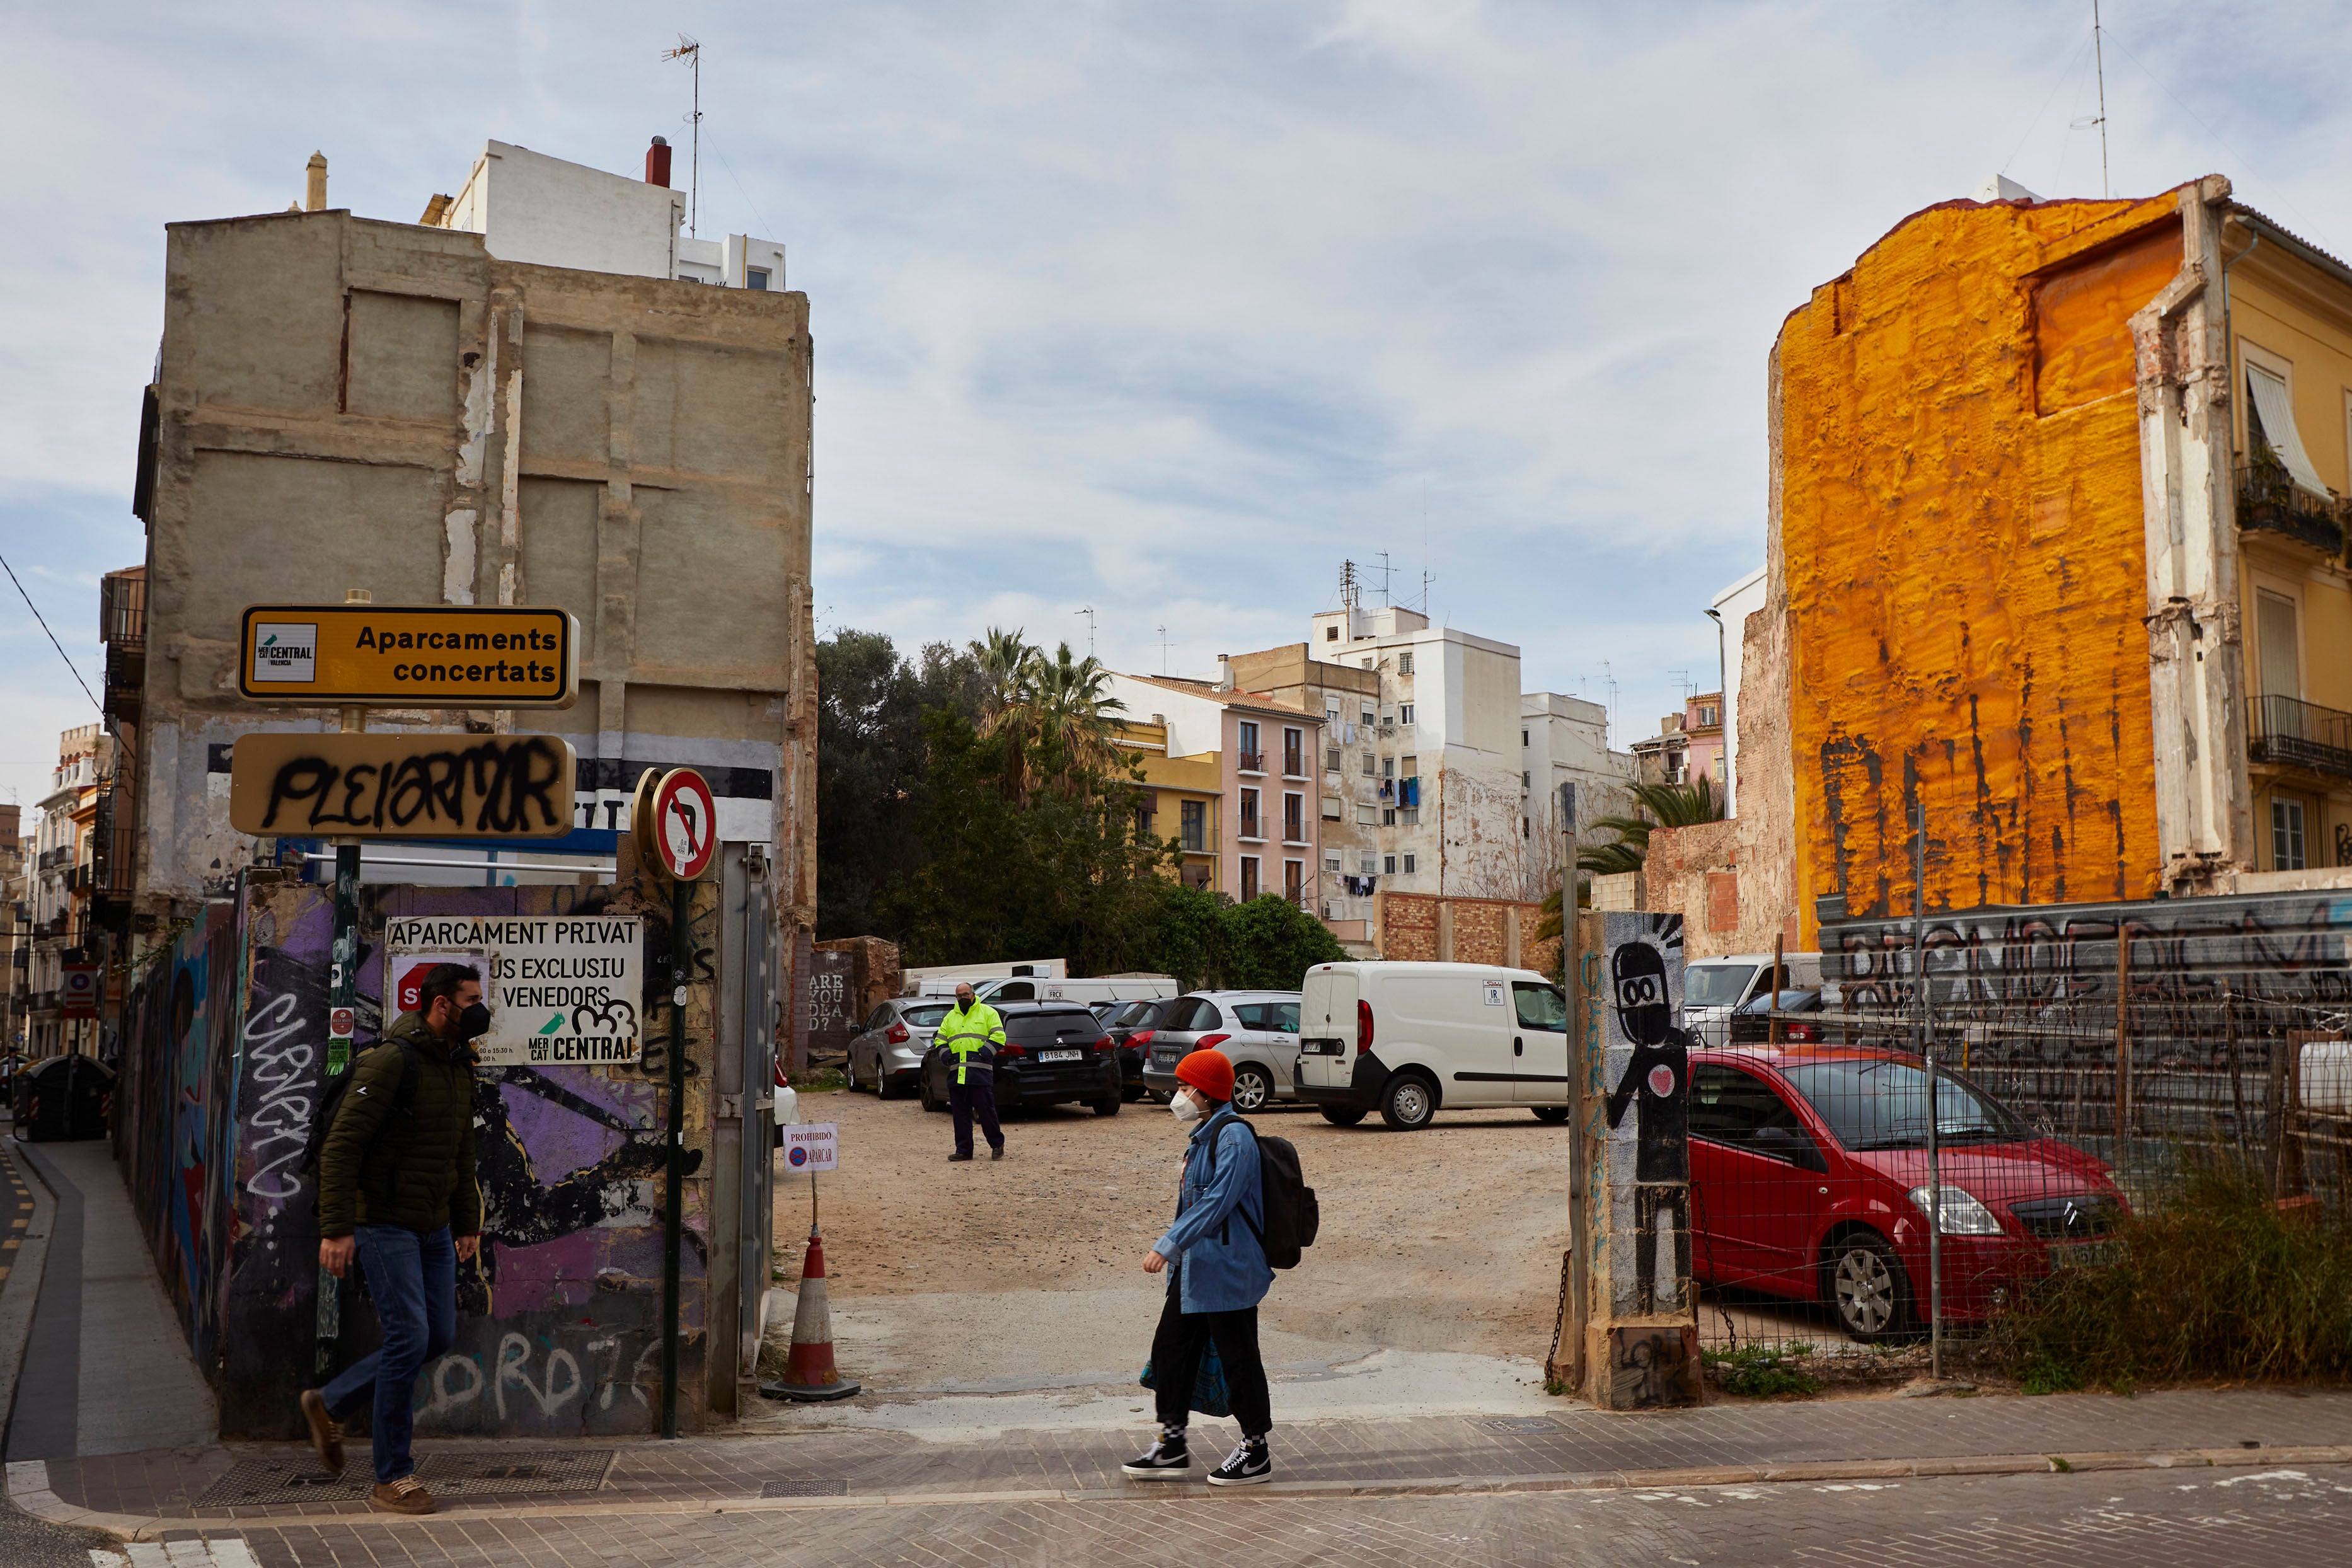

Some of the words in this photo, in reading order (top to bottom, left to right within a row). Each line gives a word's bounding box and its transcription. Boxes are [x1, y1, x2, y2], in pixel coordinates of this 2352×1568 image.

[355, 626, 557, 654] Aparcaments
[270, 647, 312, 659] CENTRAL
[393, 659, 556, 683] concertats
[391, 922, 548, 945] APARCAMENT
[555, 921, 639, 944] PRIVAT
[522, 958, 624, 979] EXCLUSIU
[809, 975, 843, 989] ARE
[503, 986, 610, 1007] VENEDORS
[809, 989, 843, 1003] YOU
[1490, 989, 1497, 998] IR
[809, 1003, 843, 1018] DEA
[528, 1038, 549, 1049] MER
[531, 1049, 548, 1061] CAT
[791, 1131, 832, 1142] PROHIBIDO
[808, 1148, 832, 1163] APARCAR
